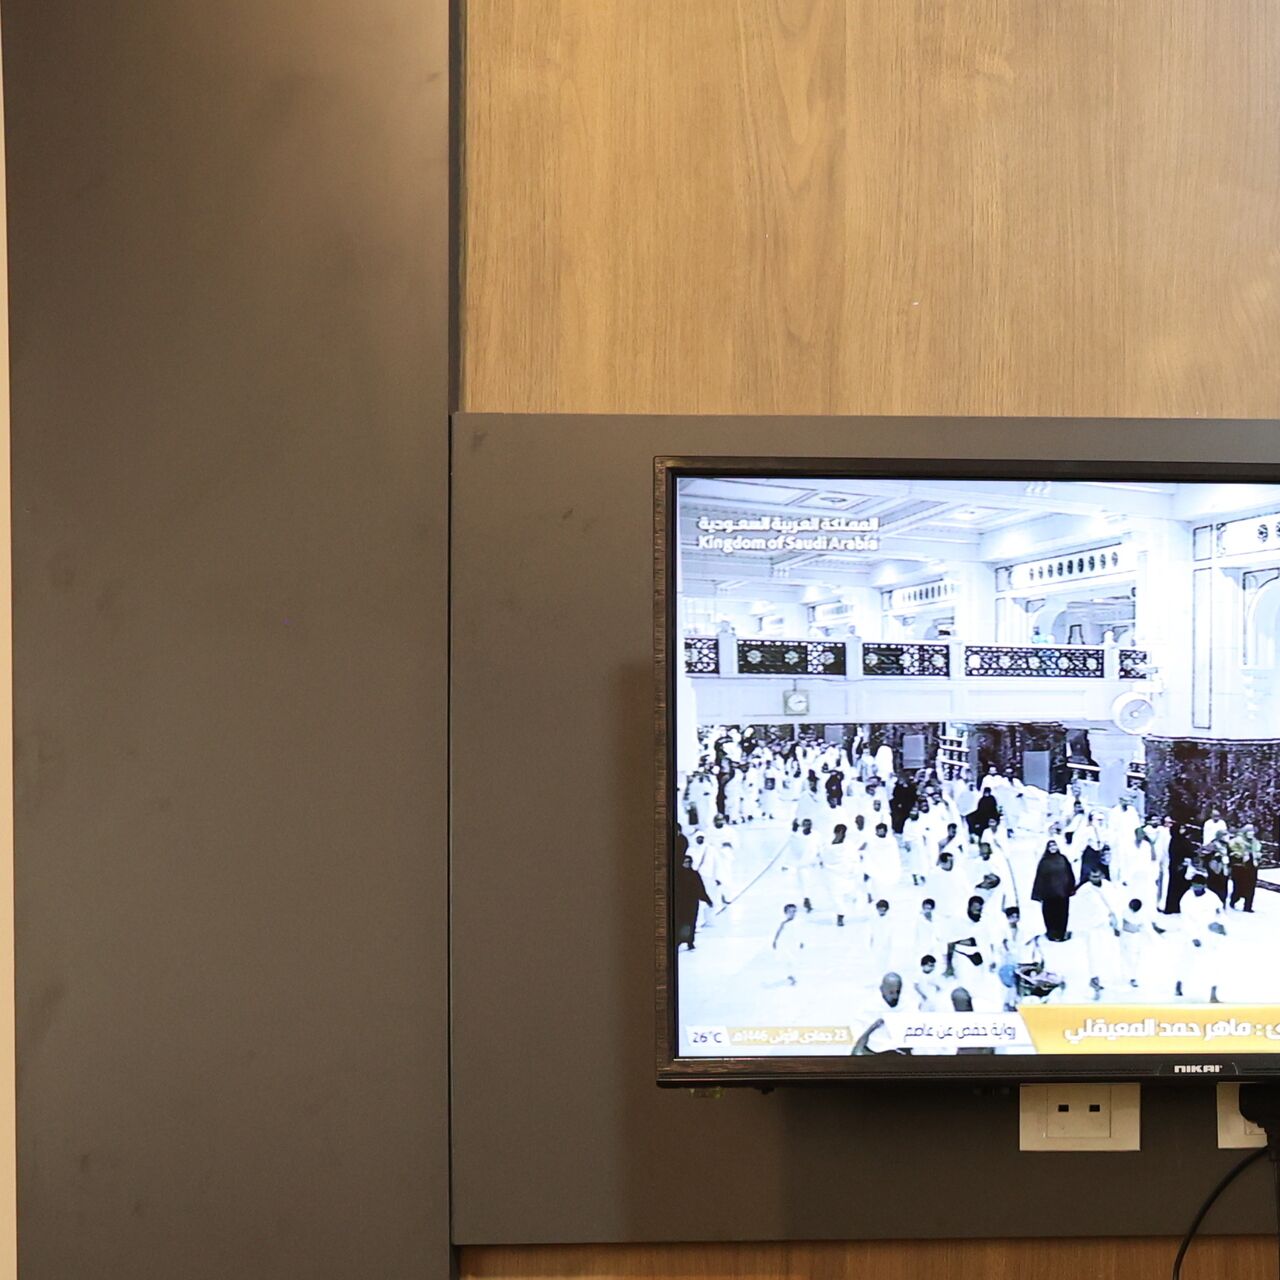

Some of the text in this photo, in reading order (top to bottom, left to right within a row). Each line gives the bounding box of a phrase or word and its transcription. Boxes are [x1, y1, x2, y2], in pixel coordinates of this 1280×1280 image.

[698, 516, 880, 534] المملكة العربية السعودية
[698, 535, 879, 553] Kingdom of Saudi Arabia
[904, 1023, 1016, 1042] رواية حفص عن عاصم
[1064, 1018, 1156, 1042] المعيقلي
[1158, 1018, 1202, 1038] حمد
[1203, 1018, 1251, 1041] ماهر
